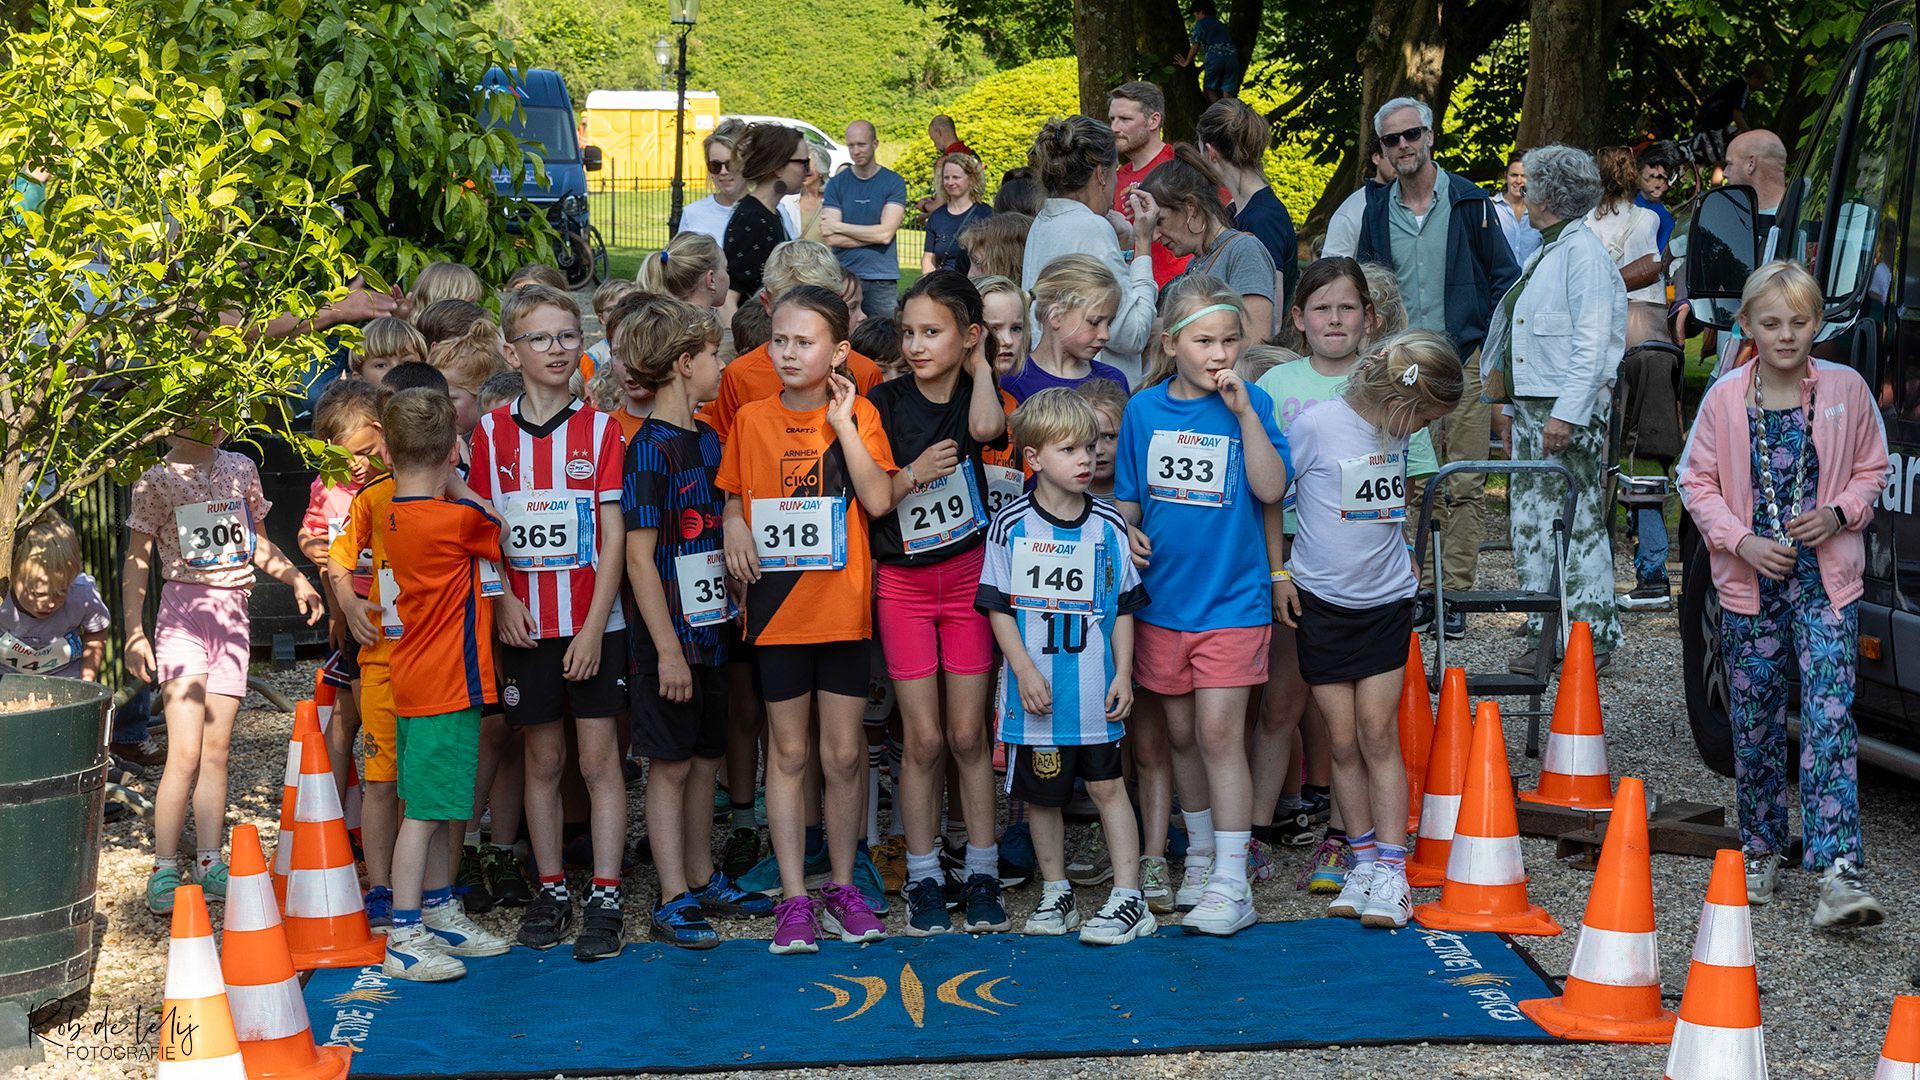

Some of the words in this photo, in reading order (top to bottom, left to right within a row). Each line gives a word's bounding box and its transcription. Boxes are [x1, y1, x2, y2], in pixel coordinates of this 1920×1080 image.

[783, 449, 818, 457] ARNHEM
[1158, 455, 1214, 483] 333
[1355, 475, 1405, 503] 466
[910, 495, 964, 531] 219
[193, 522, 243, 550] 306
[511, 524, 567, 549] 365
[764, 523, 820, 549] 318
[694, 576, 728, 604] 35
[1026, 565, 1084, 592] 146
[1041, 612, 1088, 655] 10
